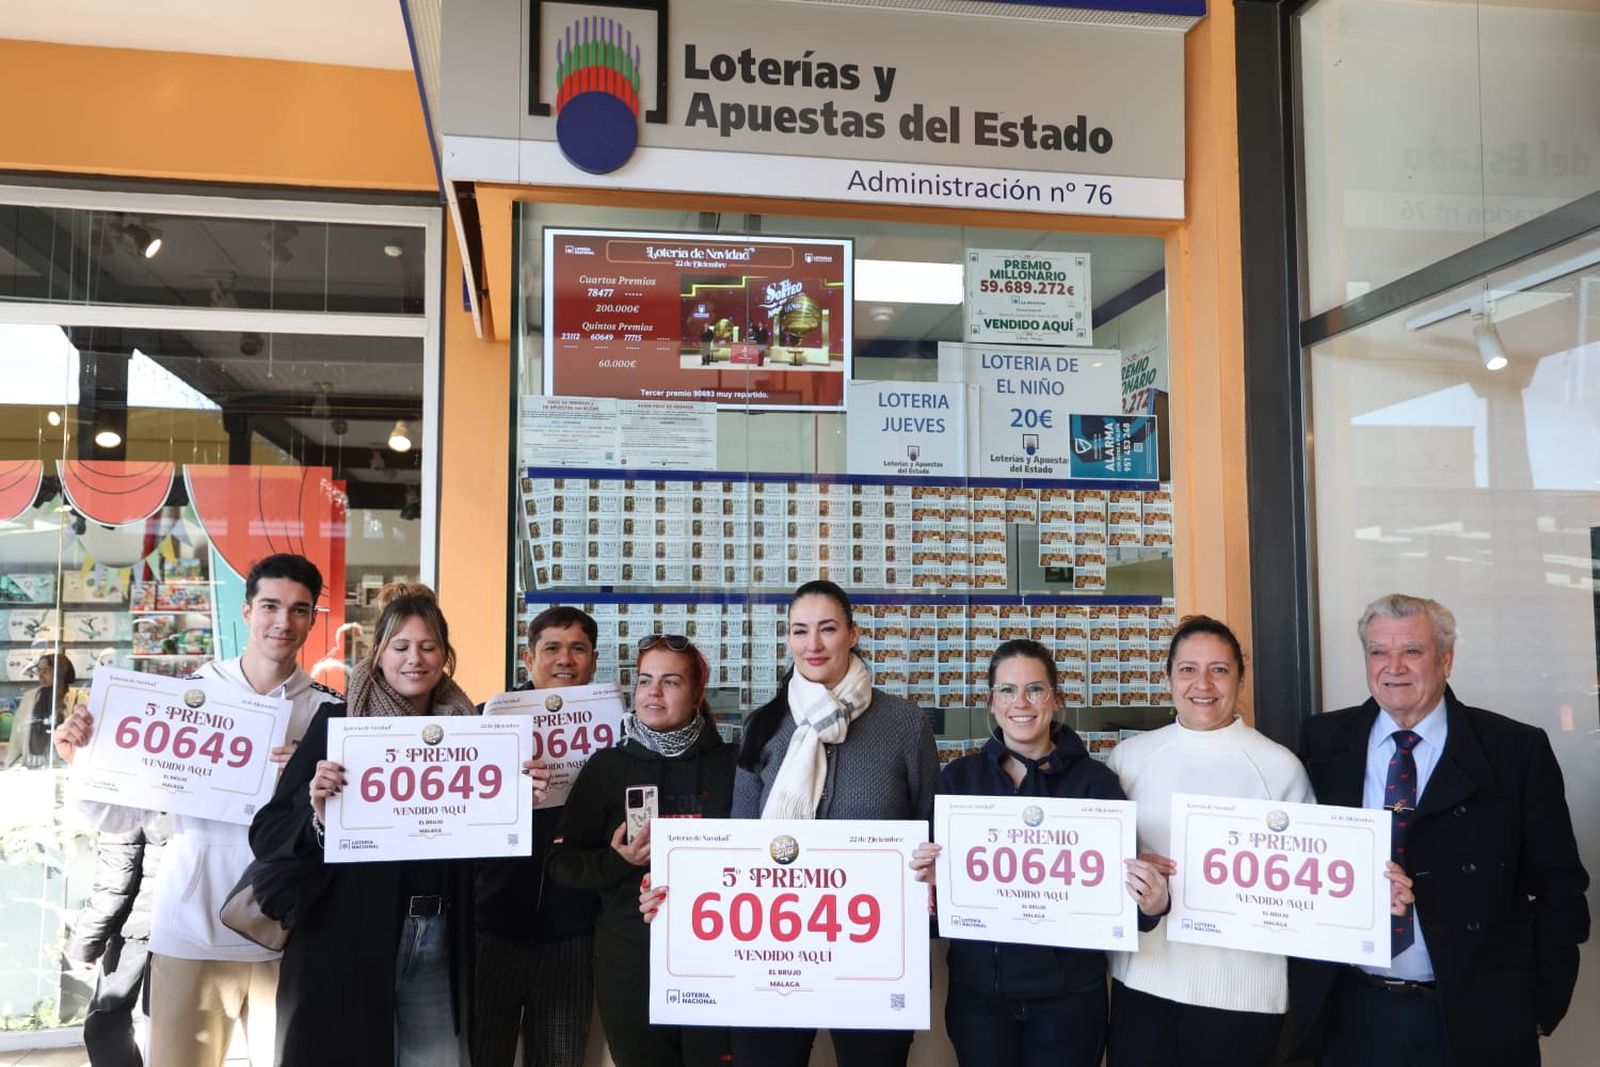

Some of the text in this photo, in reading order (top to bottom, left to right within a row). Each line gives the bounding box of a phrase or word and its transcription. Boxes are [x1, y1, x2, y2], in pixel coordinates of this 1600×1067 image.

[684, 44, 897, 102] Loterías y
[684, 91, 1114, 155] Apuestas del Estado
[847, 169, 1041, 202] Administración
[1085, 183, 1113, 206] 76
[690, 248, 705, 259] de
[705, 247, 755, 260] Navidad
[1004, 259, 1052, 271] PREMIO
[579, 274, 616, 286] Cuartos
[989, 269, 1067, 282] MILLONARIO
[587, 288, 614, 298] 78477
[979, 279, 1075, 296] 59.689.272€
[581, 321, 617, 333] Quintos
[983, 317, 1074, 333] VENDIDO AQUÍ
[981, 353, 1079, 373] LOTERIA DE
[640, 388, 664, 398] Tercer
[665, 390, 692, 400] premio
[716, 391, 733, 400] muy
[996, 377, 1065, 396] EL NIÑO
[878, 392, 950, 410] LOTERIA
[881, 417, 946, 433] JUEVES
[1009, 408, 1054, 429] 20€
[1104, 422, 1115, 472] ALARMA
[1026, 457, 1032, 465] y
[1033, 456, 1068, 465] Apuesta
[1009, 465, 1053, 474] del Estado
[165, 705, 235, 731] PREMIO
[533, 711, 593, 729] PREMIO
[114, 715, 254, 769] 60649
[406, 747, 479, 763] PREMIO
[142, 757, 186, 772] VENDIDO
[360, 764, 503, 803] 60649
[393, 805, 439, 816] VENDIDO
[1007, 828, 1080, 846] PREMIO
[1249, 832, 1328, 855] PREMIO
[965, 845, 1105, 888] 60649
[1202, 848, 1355, 899] 60649
[749, 867, 847, 889] PREMIO
[996, 888, 1041, 900] VENDIDO
[1235, 892, 1284, 907] VENDIDO
[691, 891, 881, 944] 60649
[734, 949, 833, 965] VENDIDO AQUÍ
